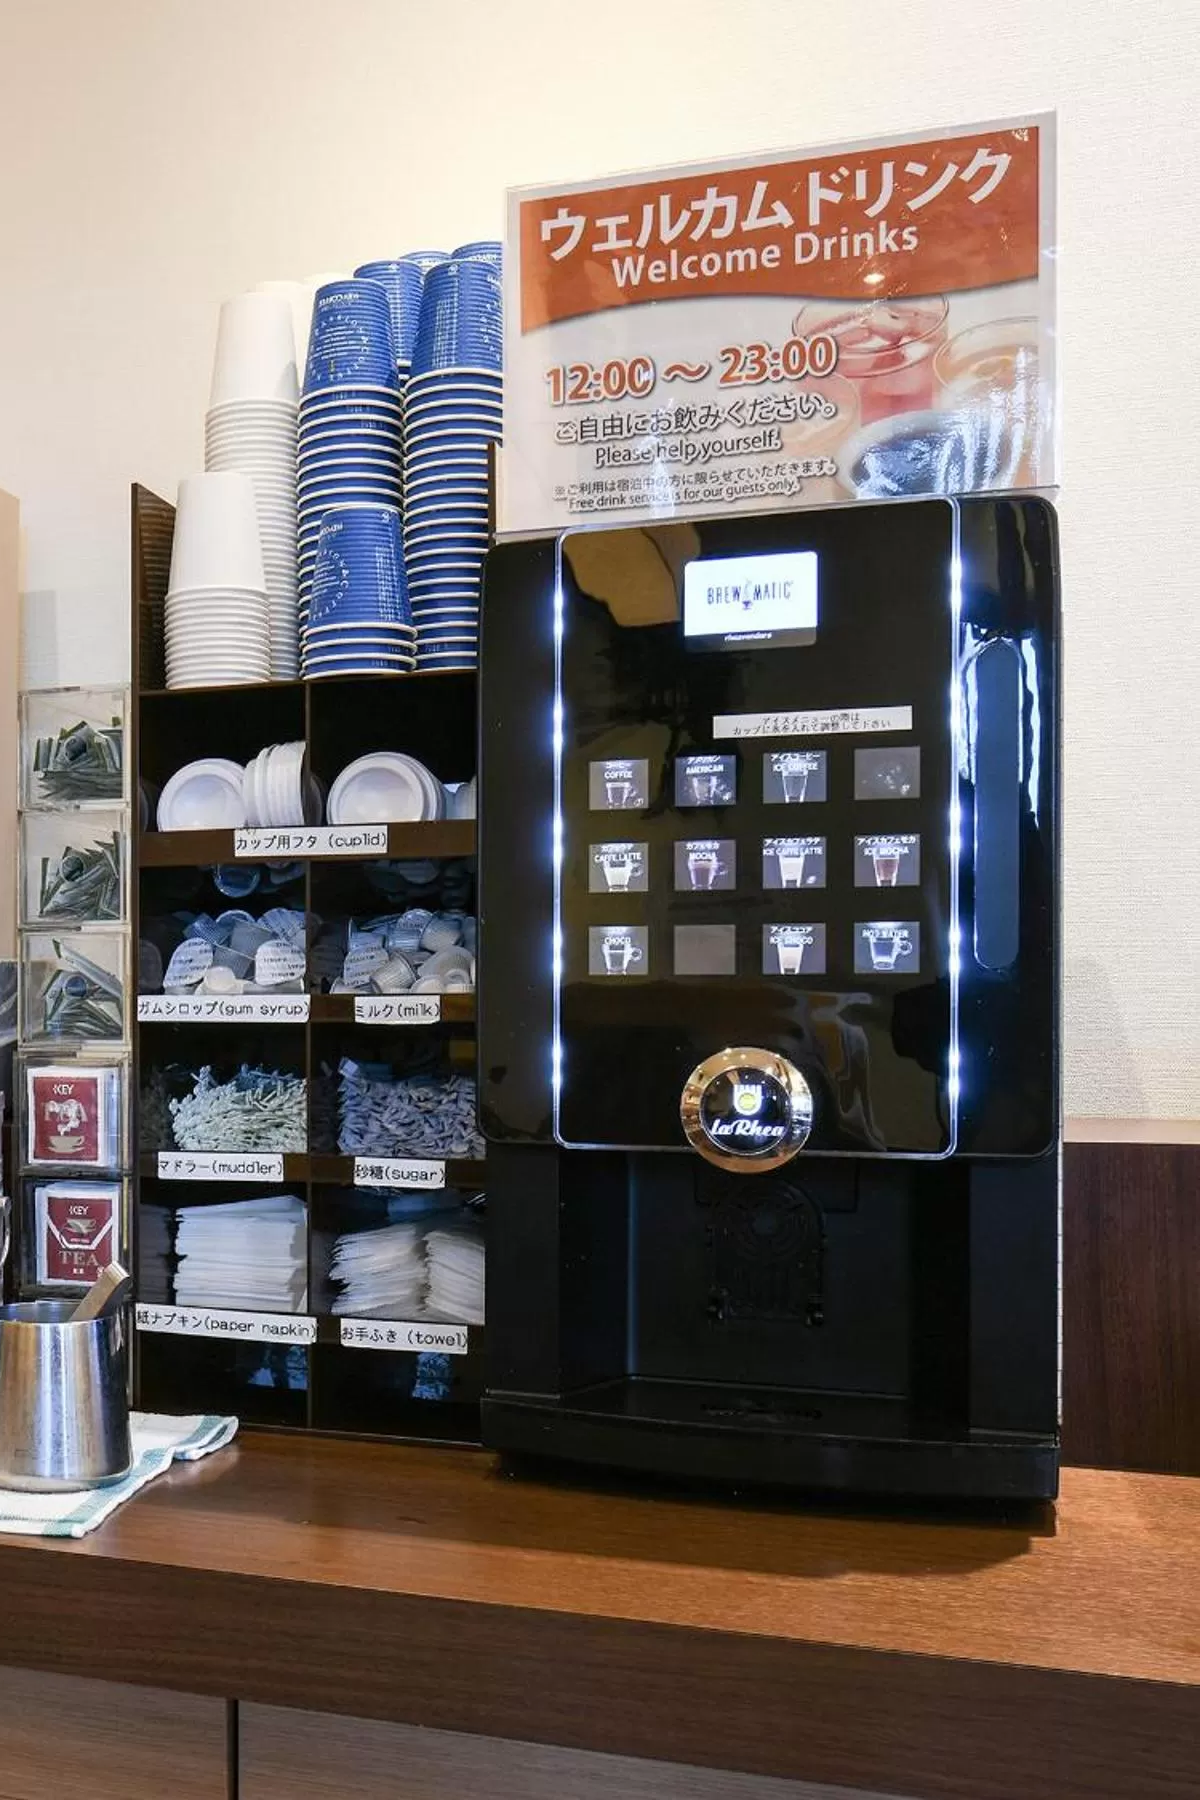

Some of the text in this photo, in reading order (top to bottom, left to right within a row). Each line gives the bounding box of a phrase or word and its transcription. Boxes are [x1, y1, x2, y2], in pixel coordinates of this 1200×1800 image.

[541, 148, 1012, 262] ウェルカムドリンク
[611, 220, 919, 288] Welcome Drinks
[546, 357, 653, 404] 12:00
[719, 335, 837, 387] 23:00
[556, 394, 837, 442] ご自由にお飲みください。
[596, 444, 650, 465] Please
[656, 438, 696, 460] help
[568, 498, 594, 510] Free
[596, 493, 627, 507] drink
[629, 491, 670, 504] service
[684, 486, 700, 499] for
[702, 487, 723, 497] our
[725, 481, 765, 498] guests
[767, 477, 798, 492] only.
[706, 585, 741, 605] BREW
[604, 770, 633, 780] COFFEE
[685, 764, 724, 775] AMERICAN
[236, 831, 387, 850] カップ用フタ (cuplid)
[260, 1001, 310, 1016] syrup)
[52, 1084, 74, 1095] KEY
[68, 1205, 89, 1215] KEY
[58, 1250, 98, 1266] TEA
[341, 1327, 467, 1348] お手ふき (towel)
